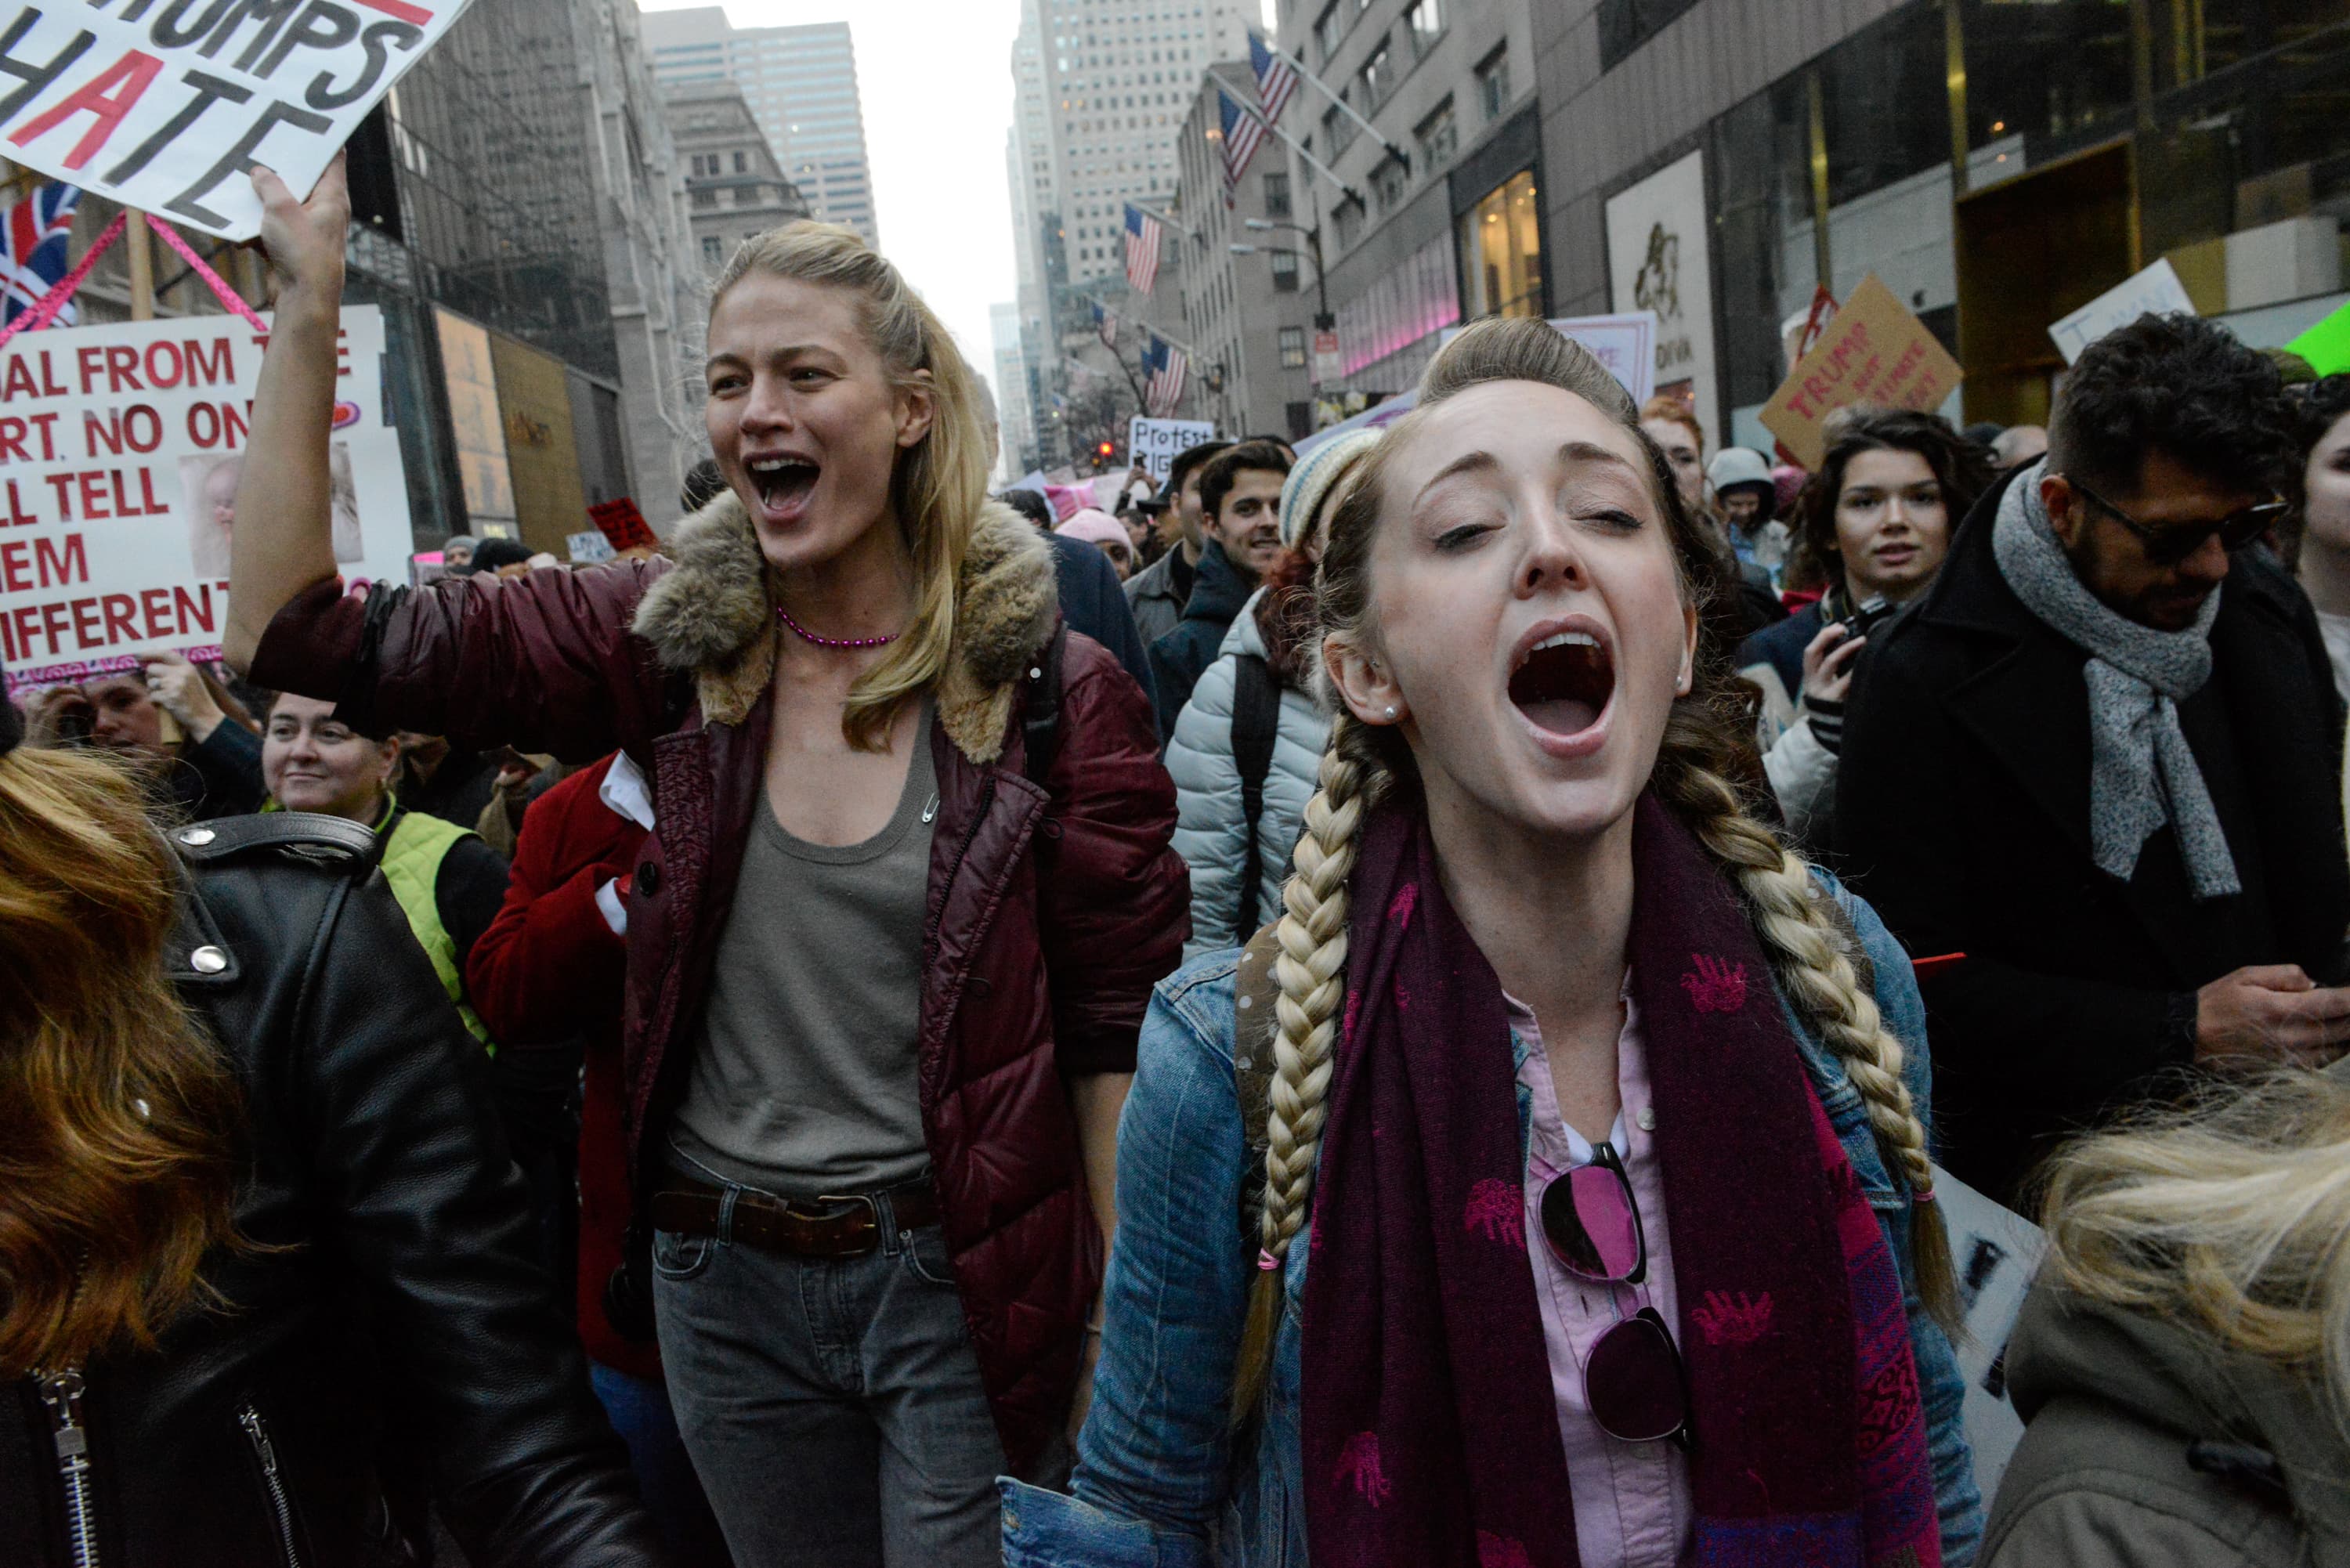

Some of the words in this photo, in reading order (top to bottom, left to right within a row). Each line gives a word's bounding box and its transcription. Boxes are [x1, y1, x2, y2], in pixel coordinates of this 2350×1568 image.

[86, 0, 424, 110] UMPS
[0, 6, 334, 229] HATE
[76, 337, 236, 394] FROM
[1787, 322, 1870, 420] TRUMP
[83, 403, 163, 458] NO
[187, 400, 255, 450] ON
[45, 467, 169, 522] TELL
[0, 533, 89, 594] EM
[0, 581, 230, 663] IFFEREN
